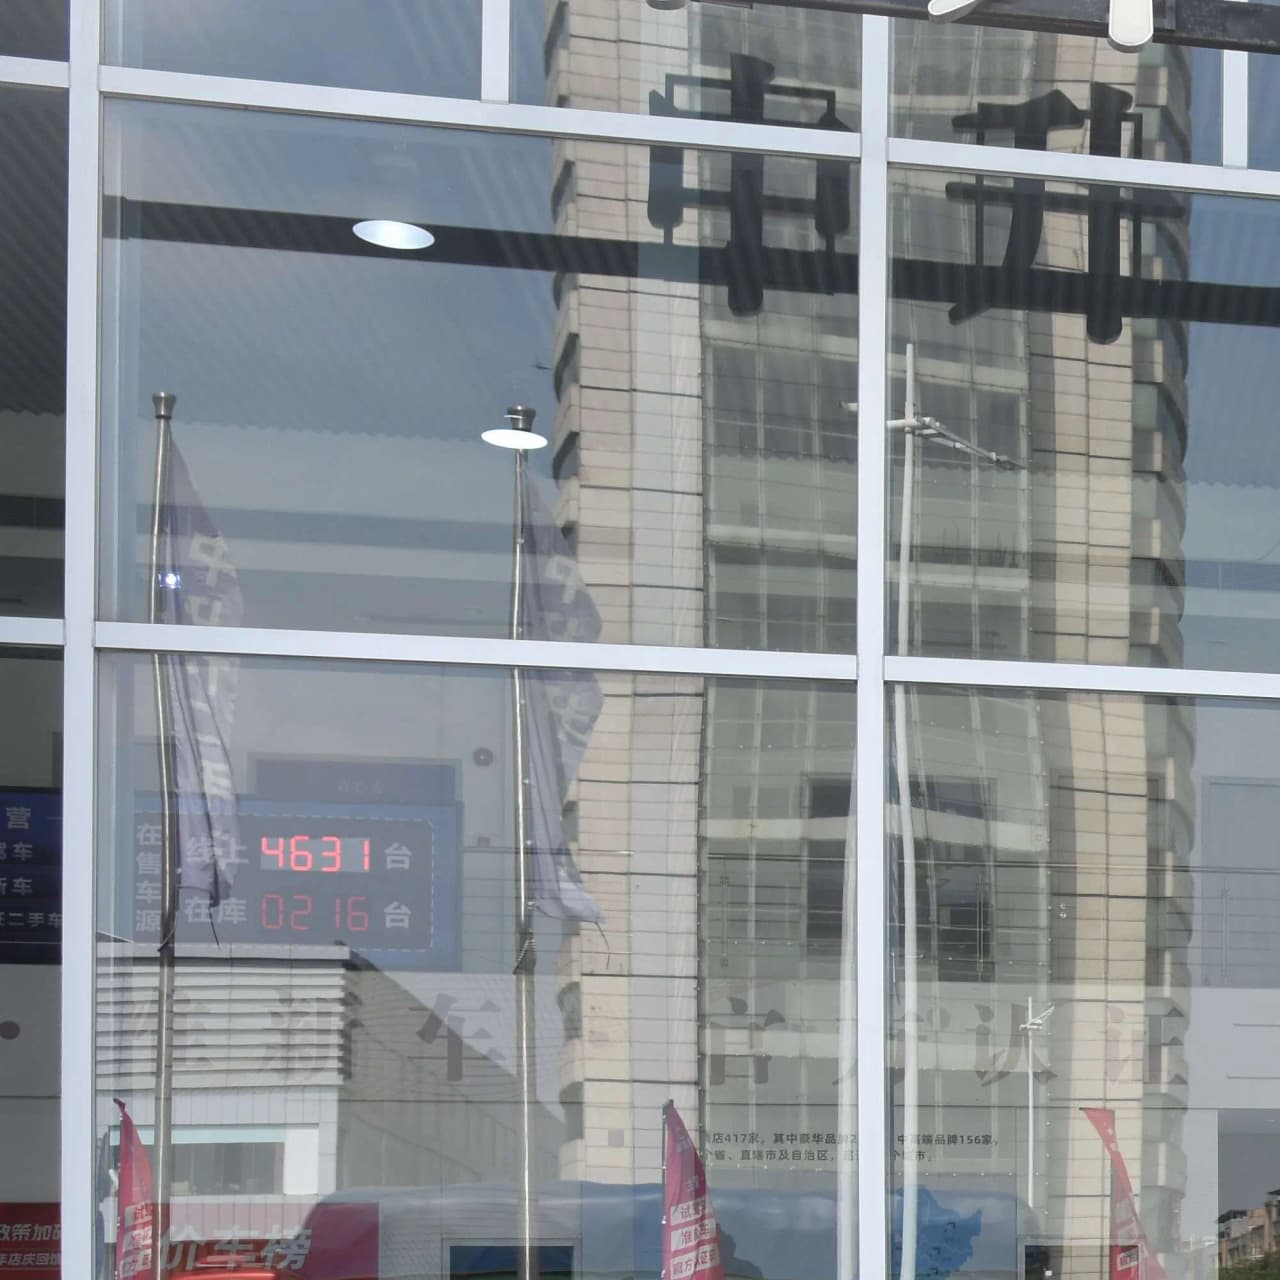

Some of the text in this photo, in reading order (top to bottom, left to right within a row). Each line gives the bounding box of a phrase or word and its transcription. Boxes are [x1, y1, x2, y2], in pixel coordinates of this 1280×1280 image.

[260, 834, 372, 873] 4631
[383, 842, 412, 871] 台
[135, 823, 163, 933] 在售车源
[184, 894, 412, 933] 在库 0216 台
